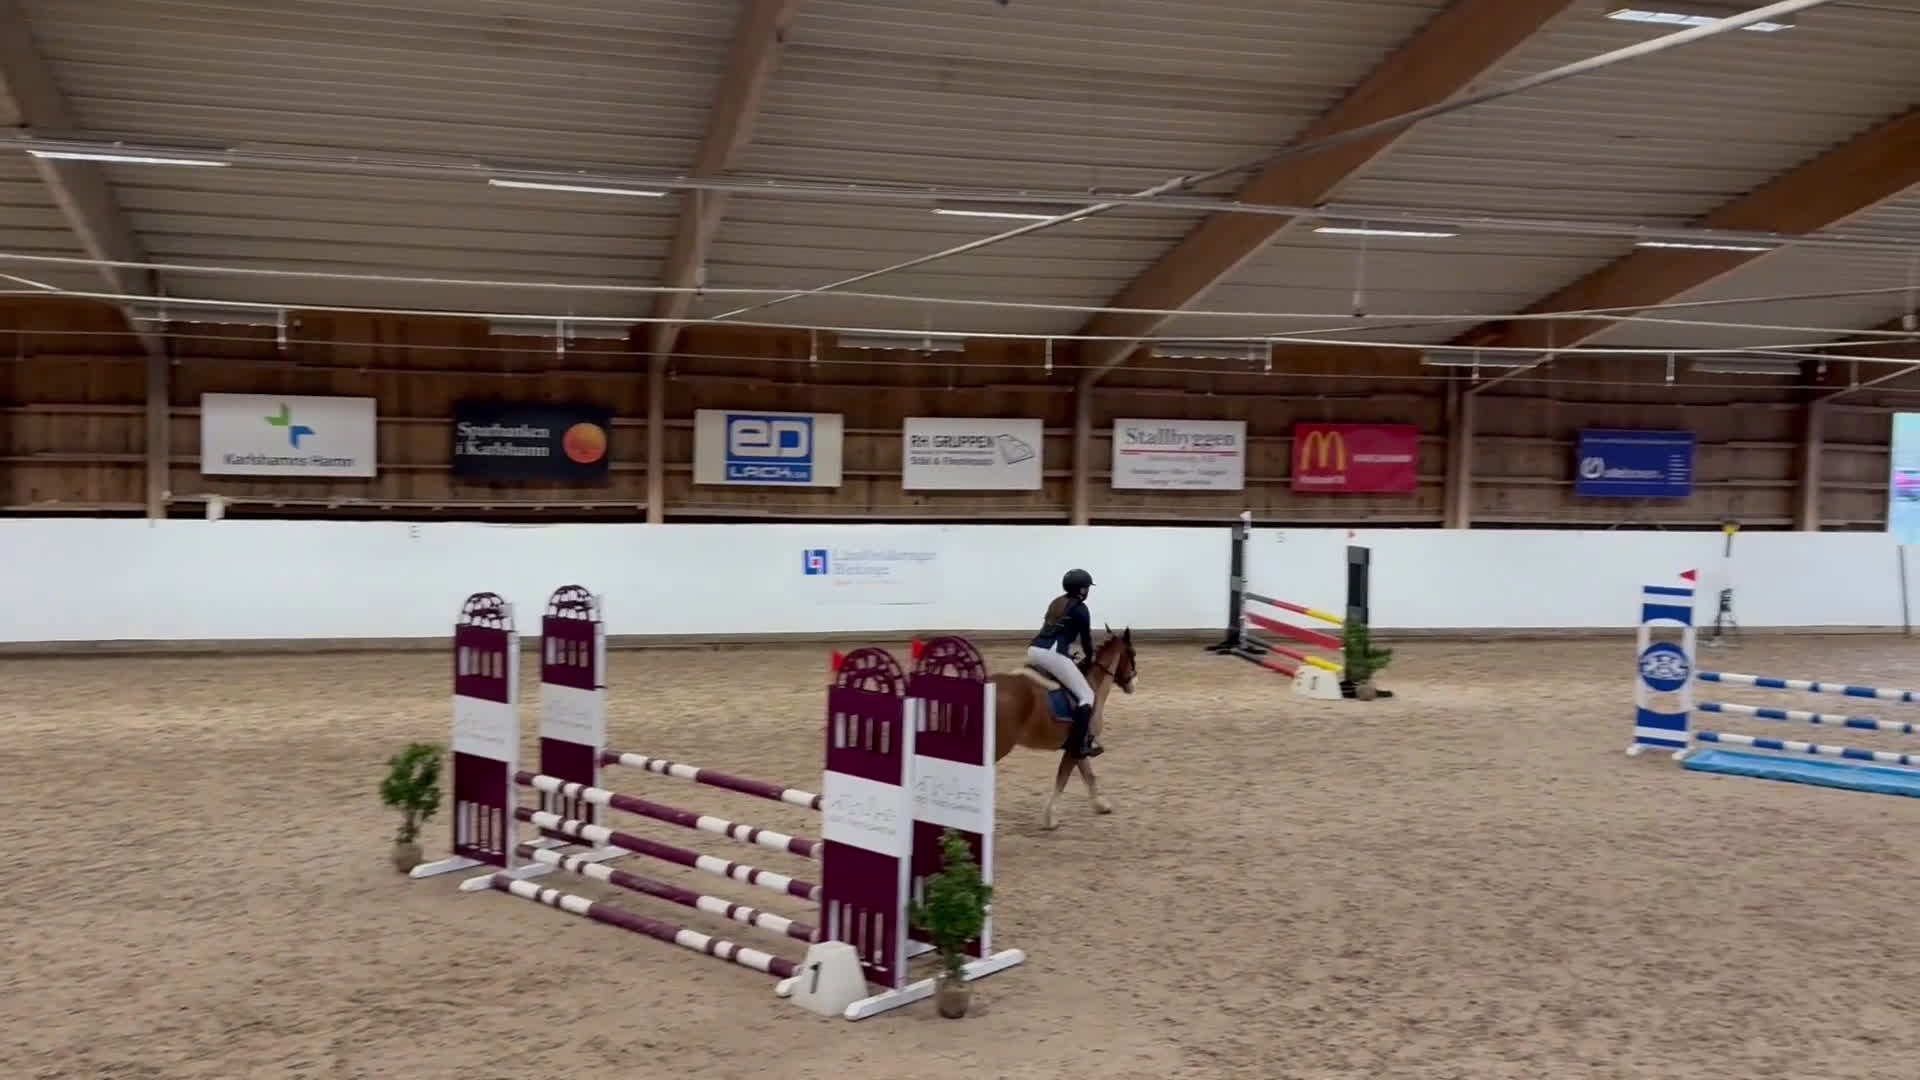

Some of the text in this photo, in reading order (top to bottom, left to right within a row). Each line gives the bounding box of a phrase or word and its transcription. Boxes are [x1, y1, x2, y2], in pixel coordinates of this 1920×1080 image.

[911, 434, 996, 449] RH GRUPPEN
[1126, 427, 1237, 449] Stallbyggen
[809, 961, 823, 994] 1
